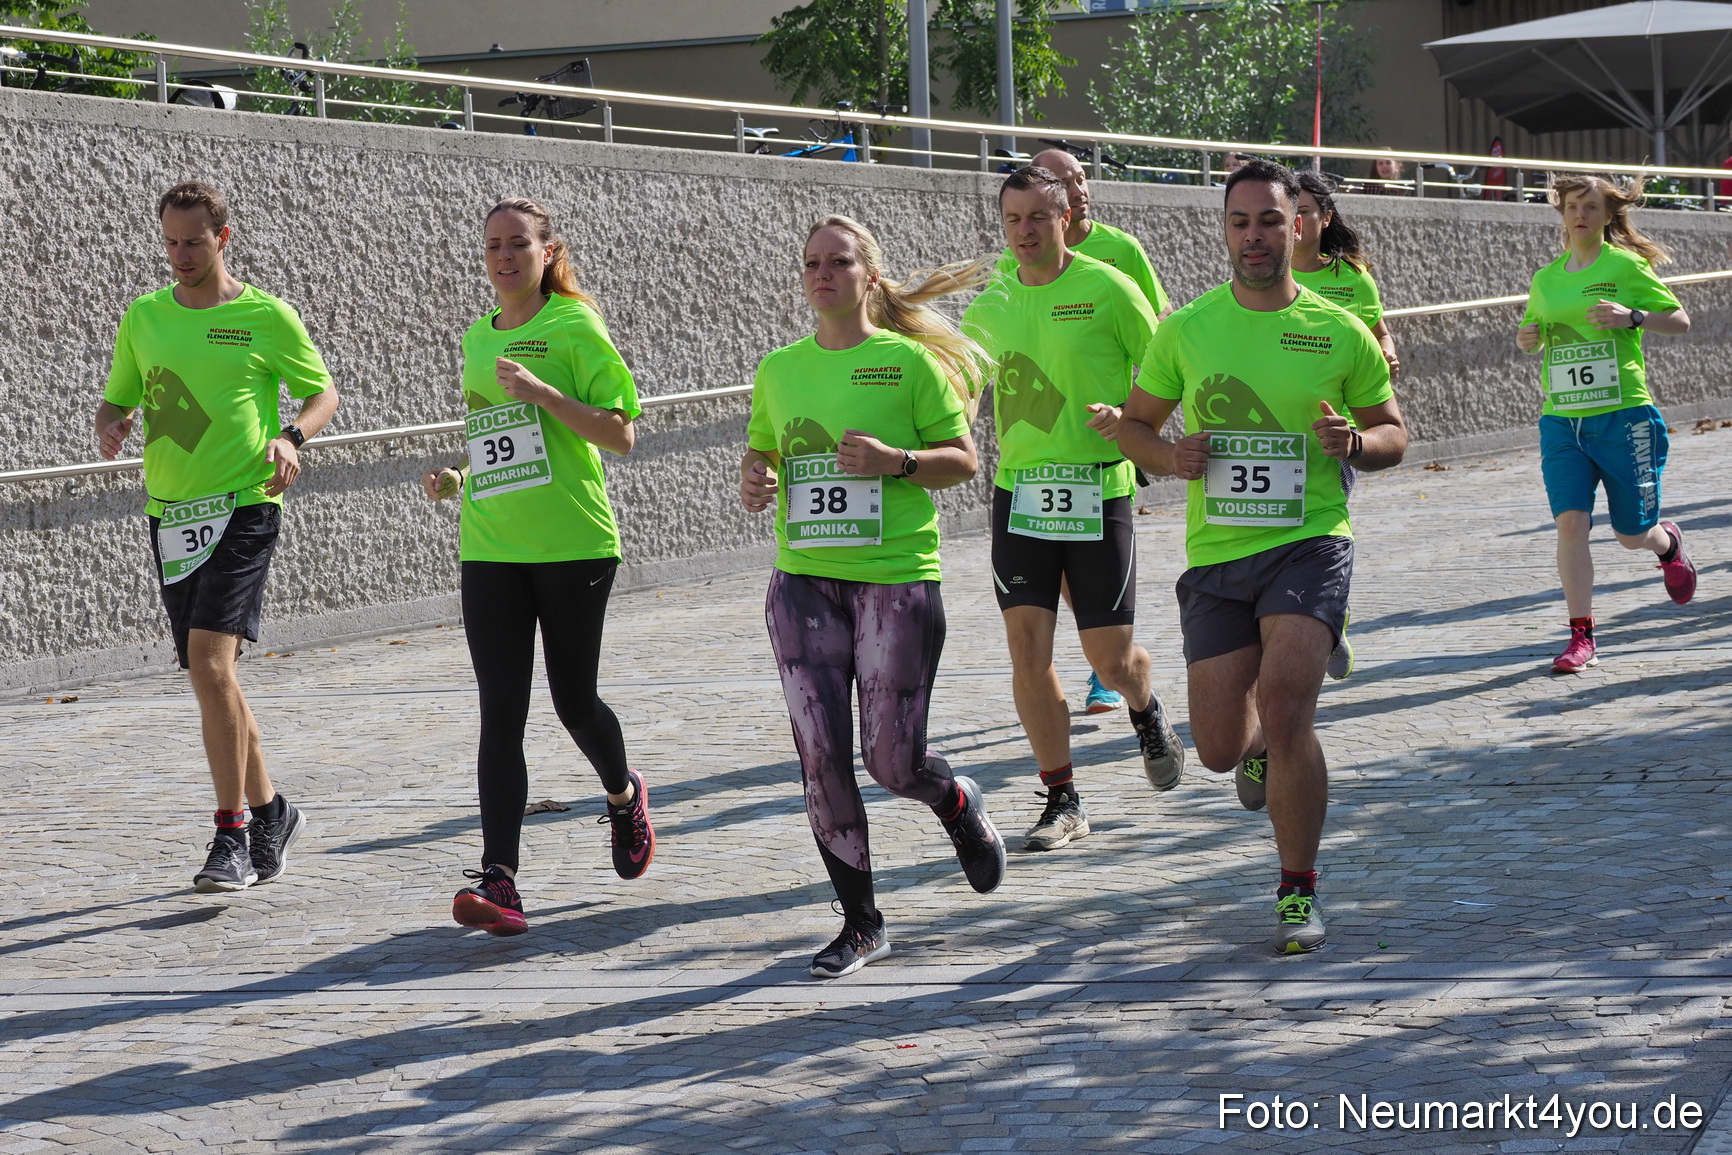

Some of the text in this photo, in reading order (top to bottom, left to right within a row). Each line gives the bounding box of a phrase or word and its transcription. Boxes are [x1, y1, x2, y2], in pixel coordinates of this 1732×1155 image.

[207, 333, 253, 342] ELEMENTELAUF
[210, 328, 251, 336] NEUMARKTER
[1283, 333, 1331, 342] NEUMARKTER
[1280, 339, 1333, 349] ELEMENTELAUF
[1552, 343, 1609, 363] BOCK
[1567, 366, 1594, 386] 16
[1559, 389, 1609, 403] STEFANIE
[467, 404, 531, 437] BOCK
[483, 436, 515, 465] 39
[1209, 435, 1297, 457] BOCK
[476, 464, 540, 488] KATHARINA
[793, 457, 859, 481] BOC
[1023, 464, 1094, 483] BOCK
[1231, 465, 1271, 493] 35
[810, 486, 848, 514] 38
[1041, 488, 1072, 512] 33
[1215, 501, 1287, 515] YOUSSEF
[161, 496, 229, 527] BOCK
[801, 523, 860, 537] MONIKA
[1027, 518, 1085, 532] THOMAS
[181, 525, 214, 553] 30
